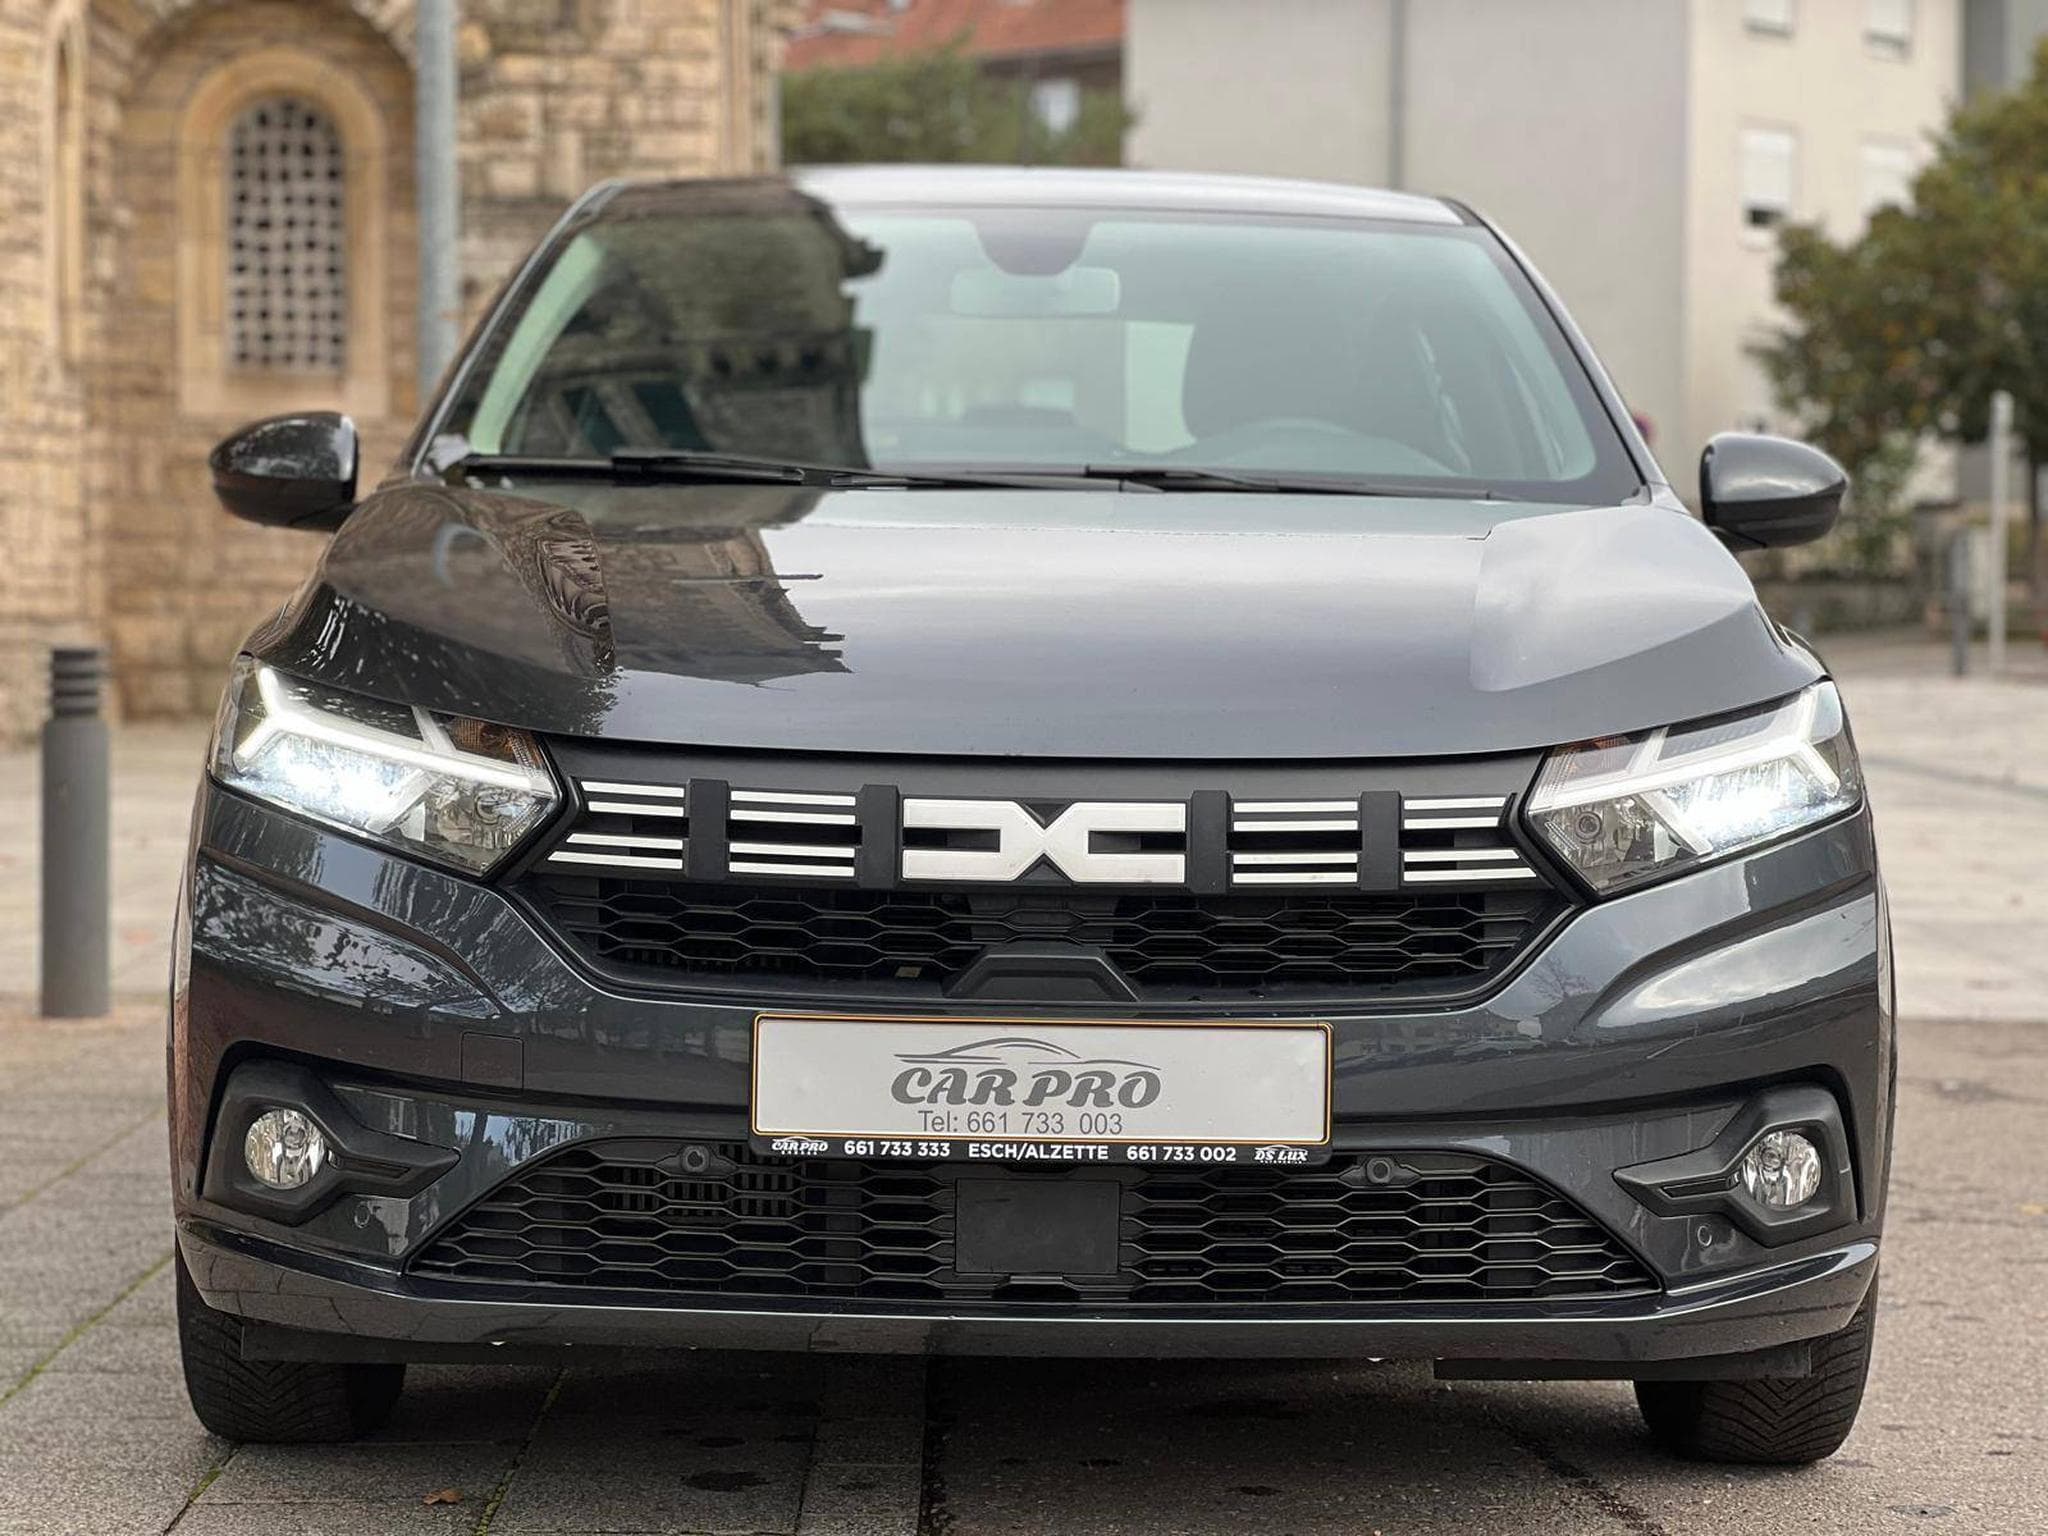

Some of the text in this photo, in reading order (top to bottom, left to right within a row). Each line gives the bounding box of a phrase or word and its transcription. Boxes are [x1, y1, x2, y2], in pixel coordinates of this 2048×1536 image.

[891, 1067, 1161, 1109] CAR PRO
[918, 1110, 1122, 1135] Tel: 661 733 003
[844, 1141, 874, 1156] 661
[880, 1141, 913, 1156] 733
[917, 1142, 950, 1157] 333
[968, 1143, 1109, 1161] ESCH/ALZETTE
[1126, 1146, 1157, 1161] 661
[1163, 1146, 1195, 1161] 733
[1200, 1147, 1237, 1162] 002
